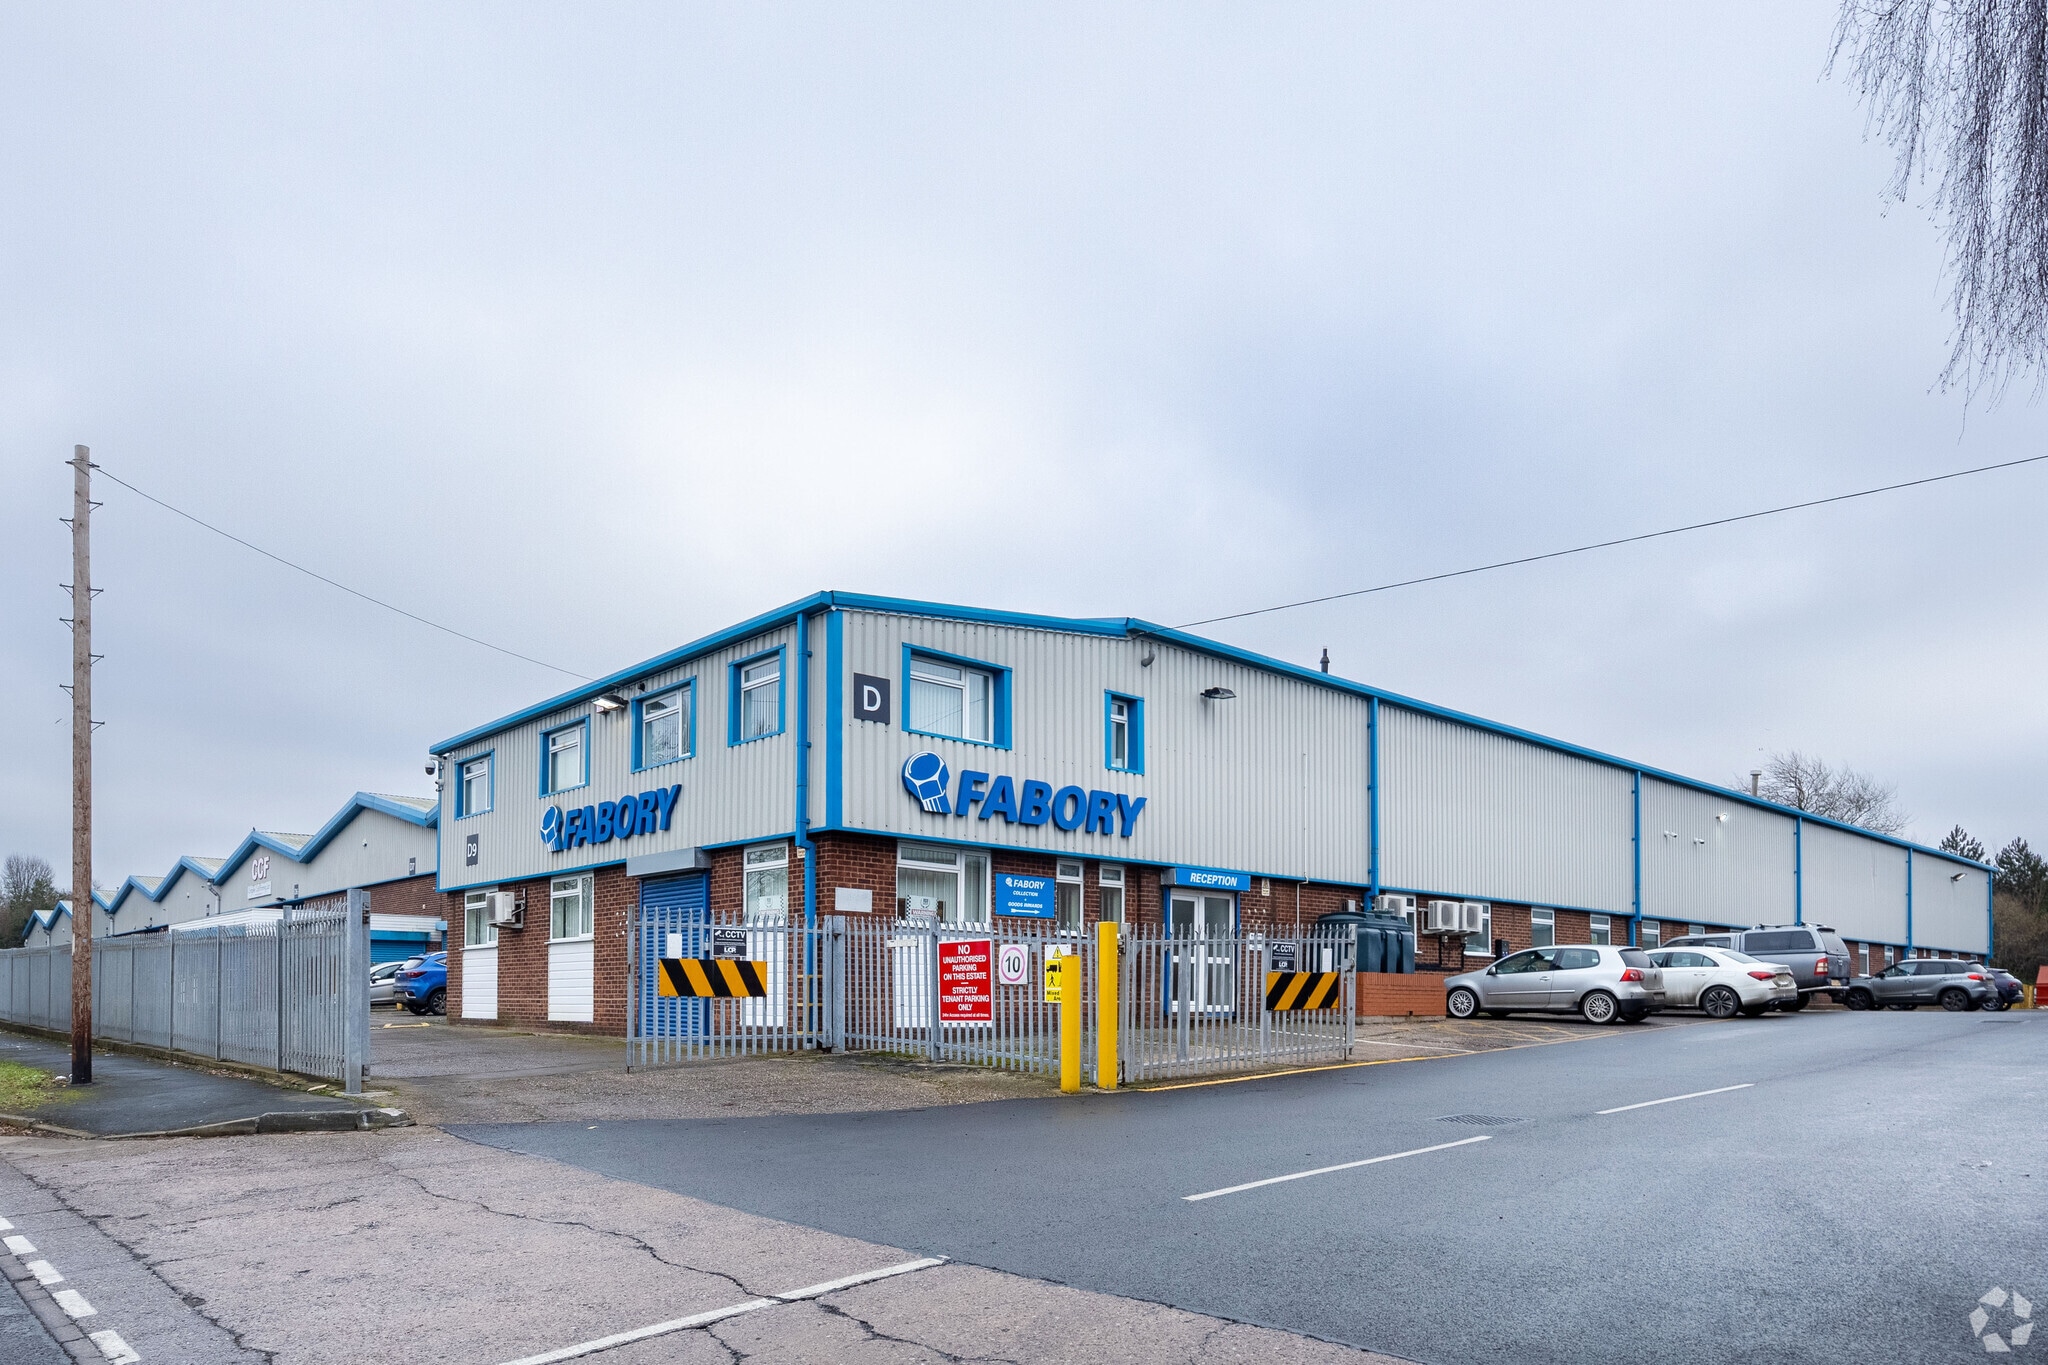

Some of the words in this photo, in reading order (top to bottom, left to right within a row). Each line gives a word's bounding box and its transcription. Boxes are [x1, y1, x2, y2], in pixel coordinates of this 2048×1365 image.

[863, 684, 881, 712] D
[955, 769, 1148, 837] FABORY
[562, 784, 682, 850] FABORY
[467, 843, 477, 858] D9
[252, 856, 270, 881] CCF
[1013, 879, 1045, 889] FABORY
[1190, 872, 1238, 887] RECEPTION
[725, 930, 745, 938] CCTV
[957, 944, 970, 954] NO
[1280, 944, 1295, 953] CCTV
[942, 955, 986, 963] UNAUTHORISED
[1005, 956, 1020, 973] 10
[966, 972, 987, 980] ESTATE
